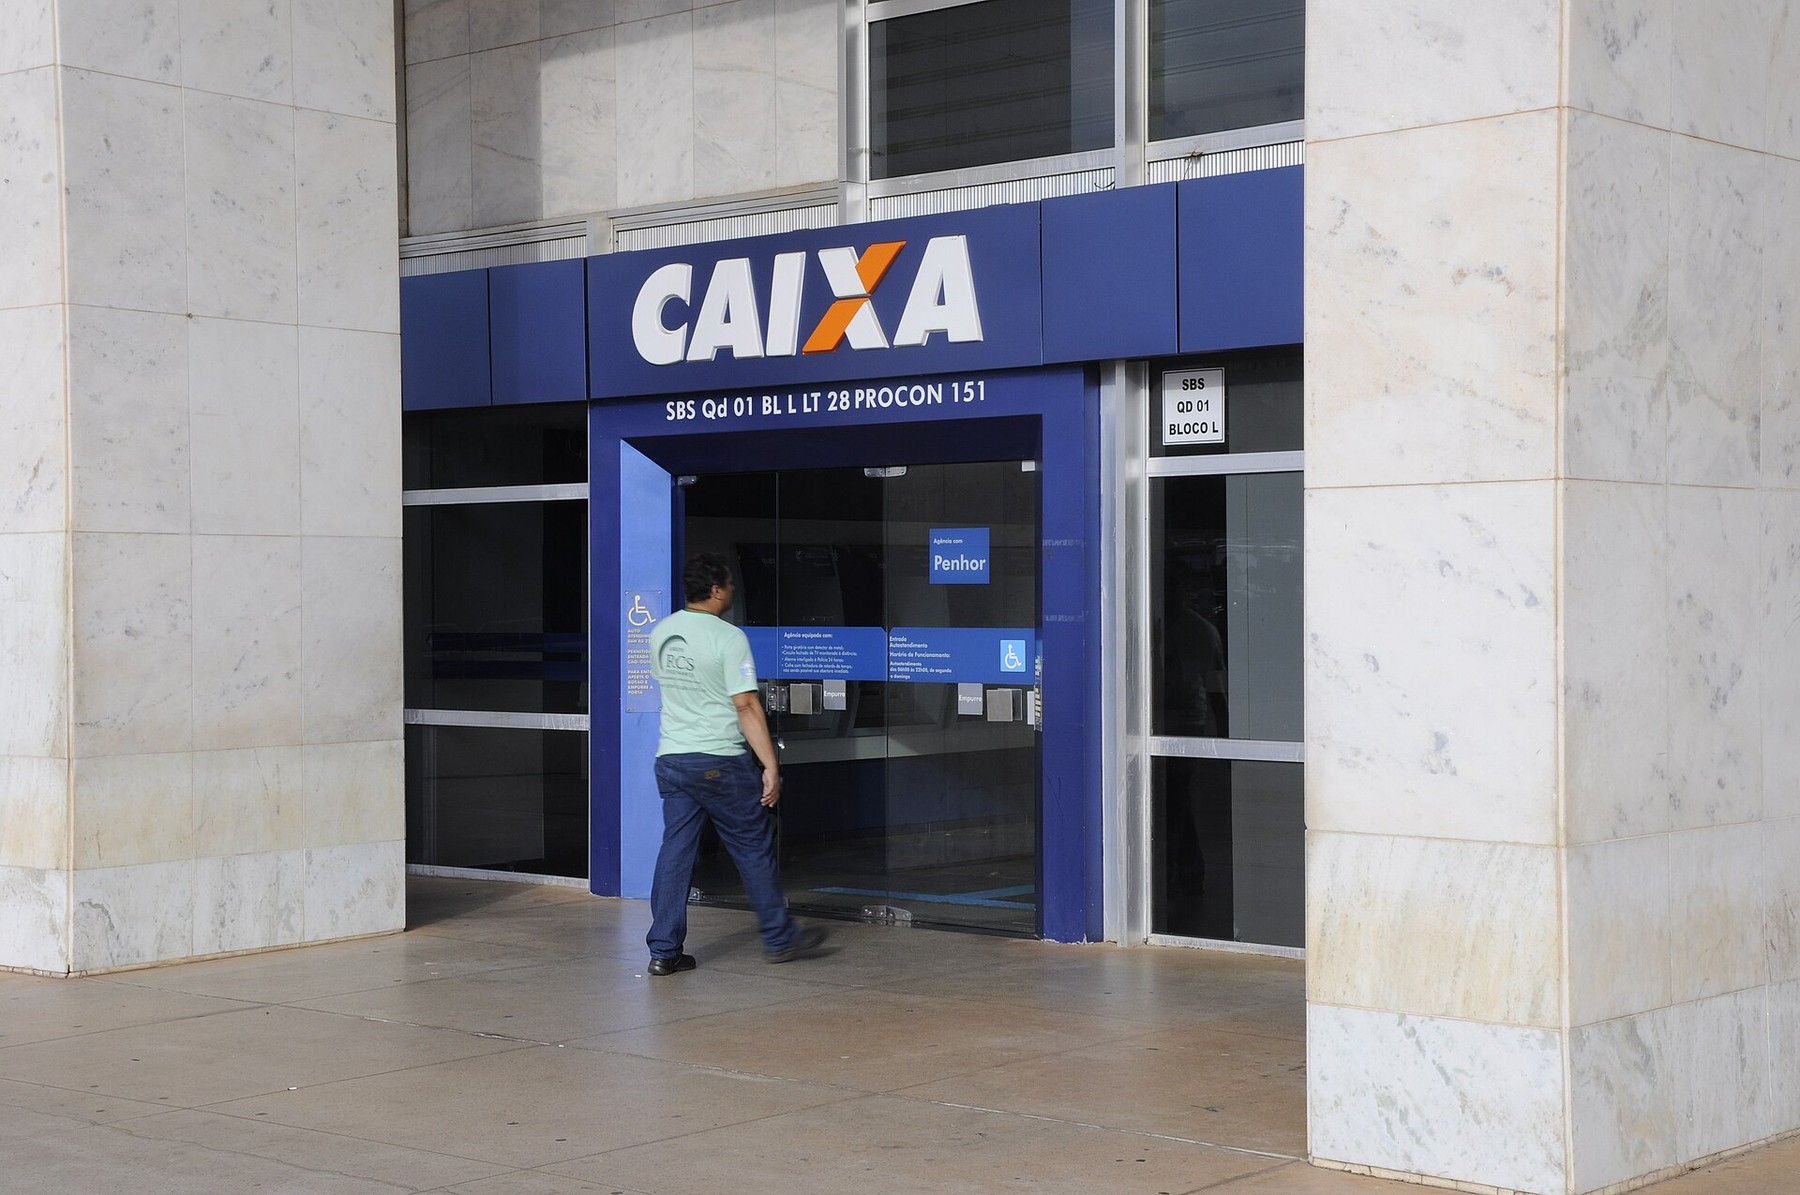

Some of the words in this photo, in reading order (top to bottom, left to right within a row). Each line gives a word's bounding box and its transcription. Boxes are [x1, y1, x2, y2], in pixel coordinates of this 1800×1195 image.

[631, 234, 984, 366] CAIXA
[1182, 378, 1205, 391] SBS
[666, 400, 696, 420] SBS
[702, 398, 727, 419] Qd
[734, 397, 752, 417] 01
[762, 395, 781, 415] BL
[788, 395, 796, 414] L
[803, 392, 821, 413] LT
[828, 390, 850, 411] 28
[855, 383, 942, 409] PROCON
[952, 381, 984, 402] 151
[1177, 401, 1193, 413] QD
[1197, 400, 1209, 412] 01
[1169, 422, 1208, 435] BLOCO
[1212, 421, 1219, 432] L
[934, 554, 986, 571] Penhor
[958, 694, 982, 702] Empurre
